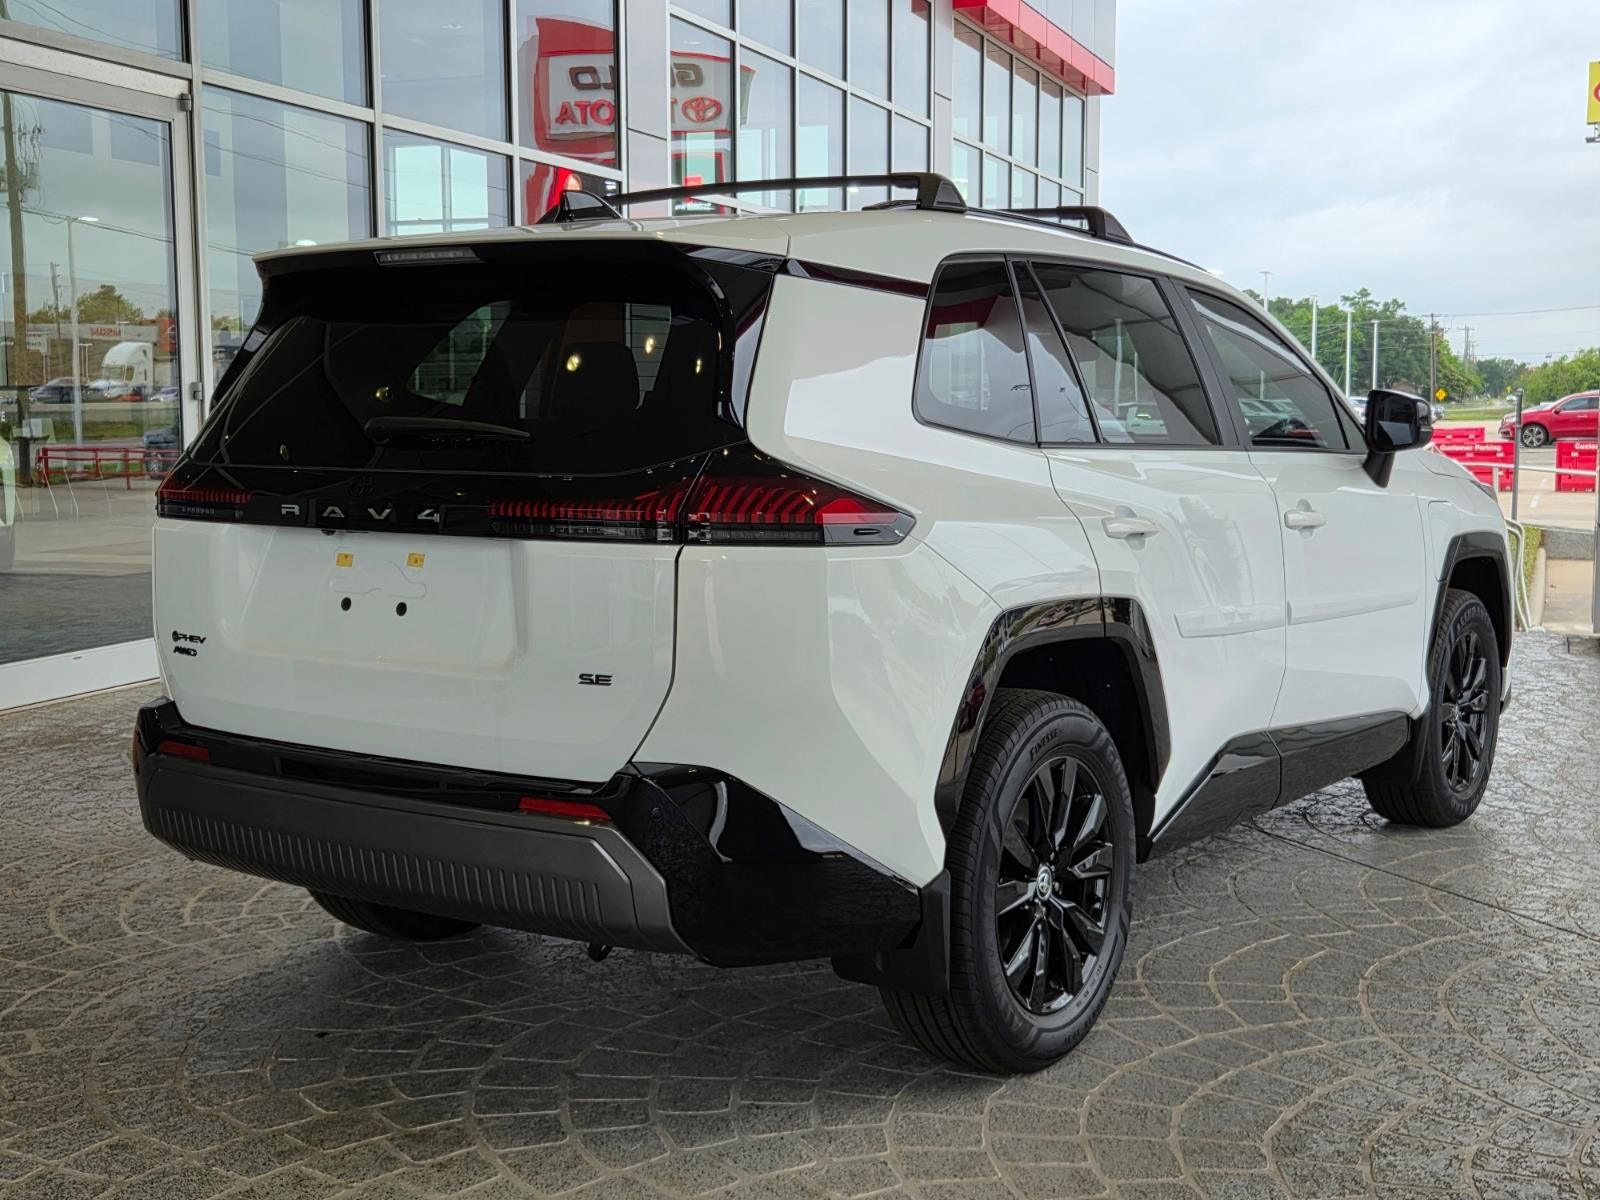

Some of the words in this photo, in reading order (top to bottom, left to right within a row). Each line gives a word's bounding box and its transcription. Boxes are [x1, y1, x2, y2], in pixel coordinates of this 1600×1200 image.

[1475, 444, 1502, 452] Parking
[281, 504, 440, 523] RAV4
[177, 632, 207, 644] PHEV
[577, 673, 613, 686] SE
[1029, 728, 1059, 761] FINESSE
